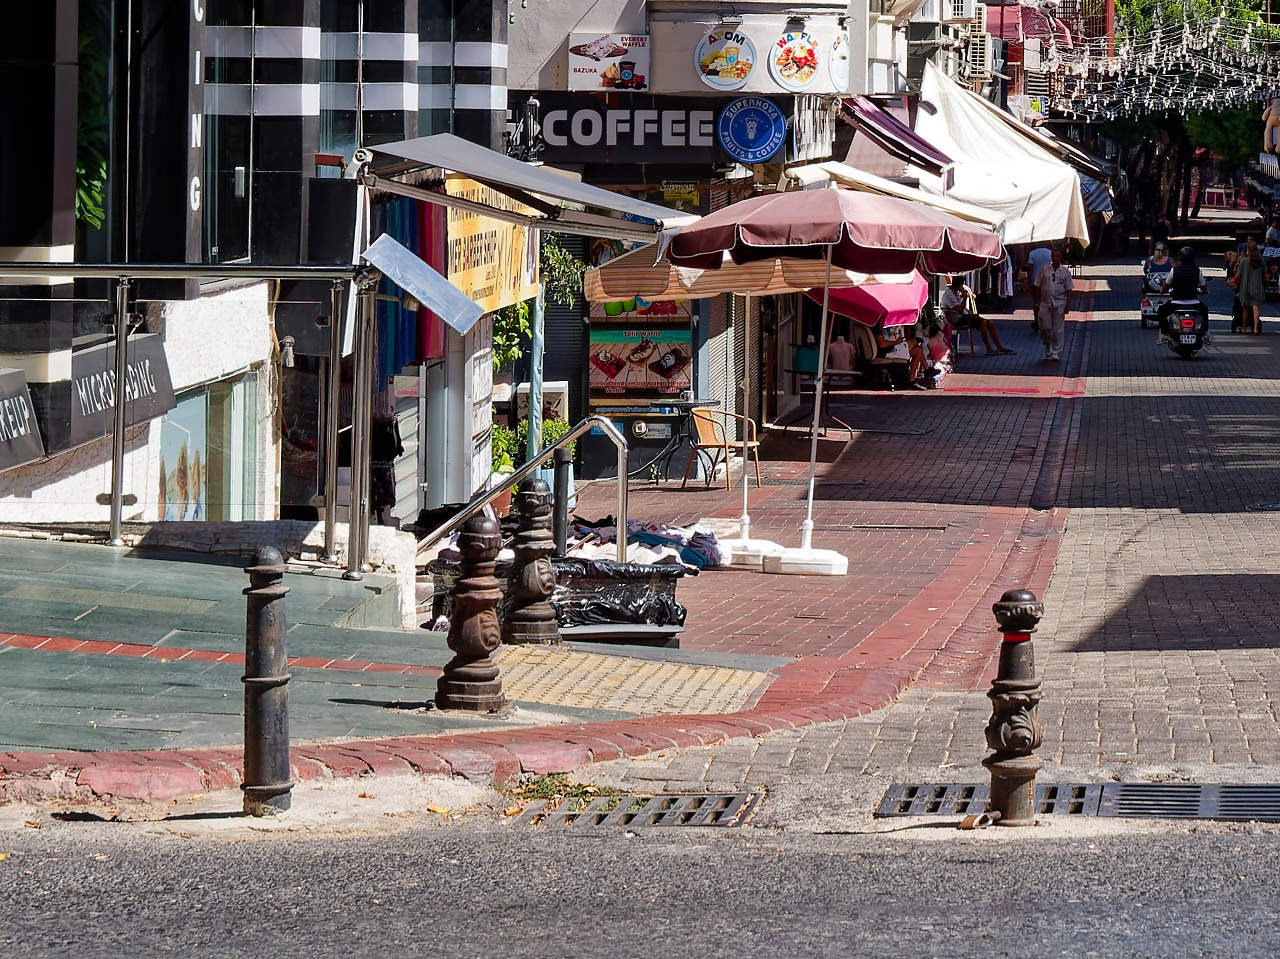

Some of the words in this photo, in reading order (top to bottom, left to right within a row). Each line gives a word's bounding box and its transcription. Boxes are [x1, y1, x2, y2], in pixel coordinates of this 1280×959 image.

[708, 31, 746, 46] ATOM
[776, 31, 819, 49] WAFFLE
[726, 98, 778, 120] SUPERNOVA
[543, 109, 714, 147] COFFEE
[722, 131, 745, 158] FRUITS
[756, 132, 782, 158] COFFEE
[0, 395, 32, 442] KEUP
